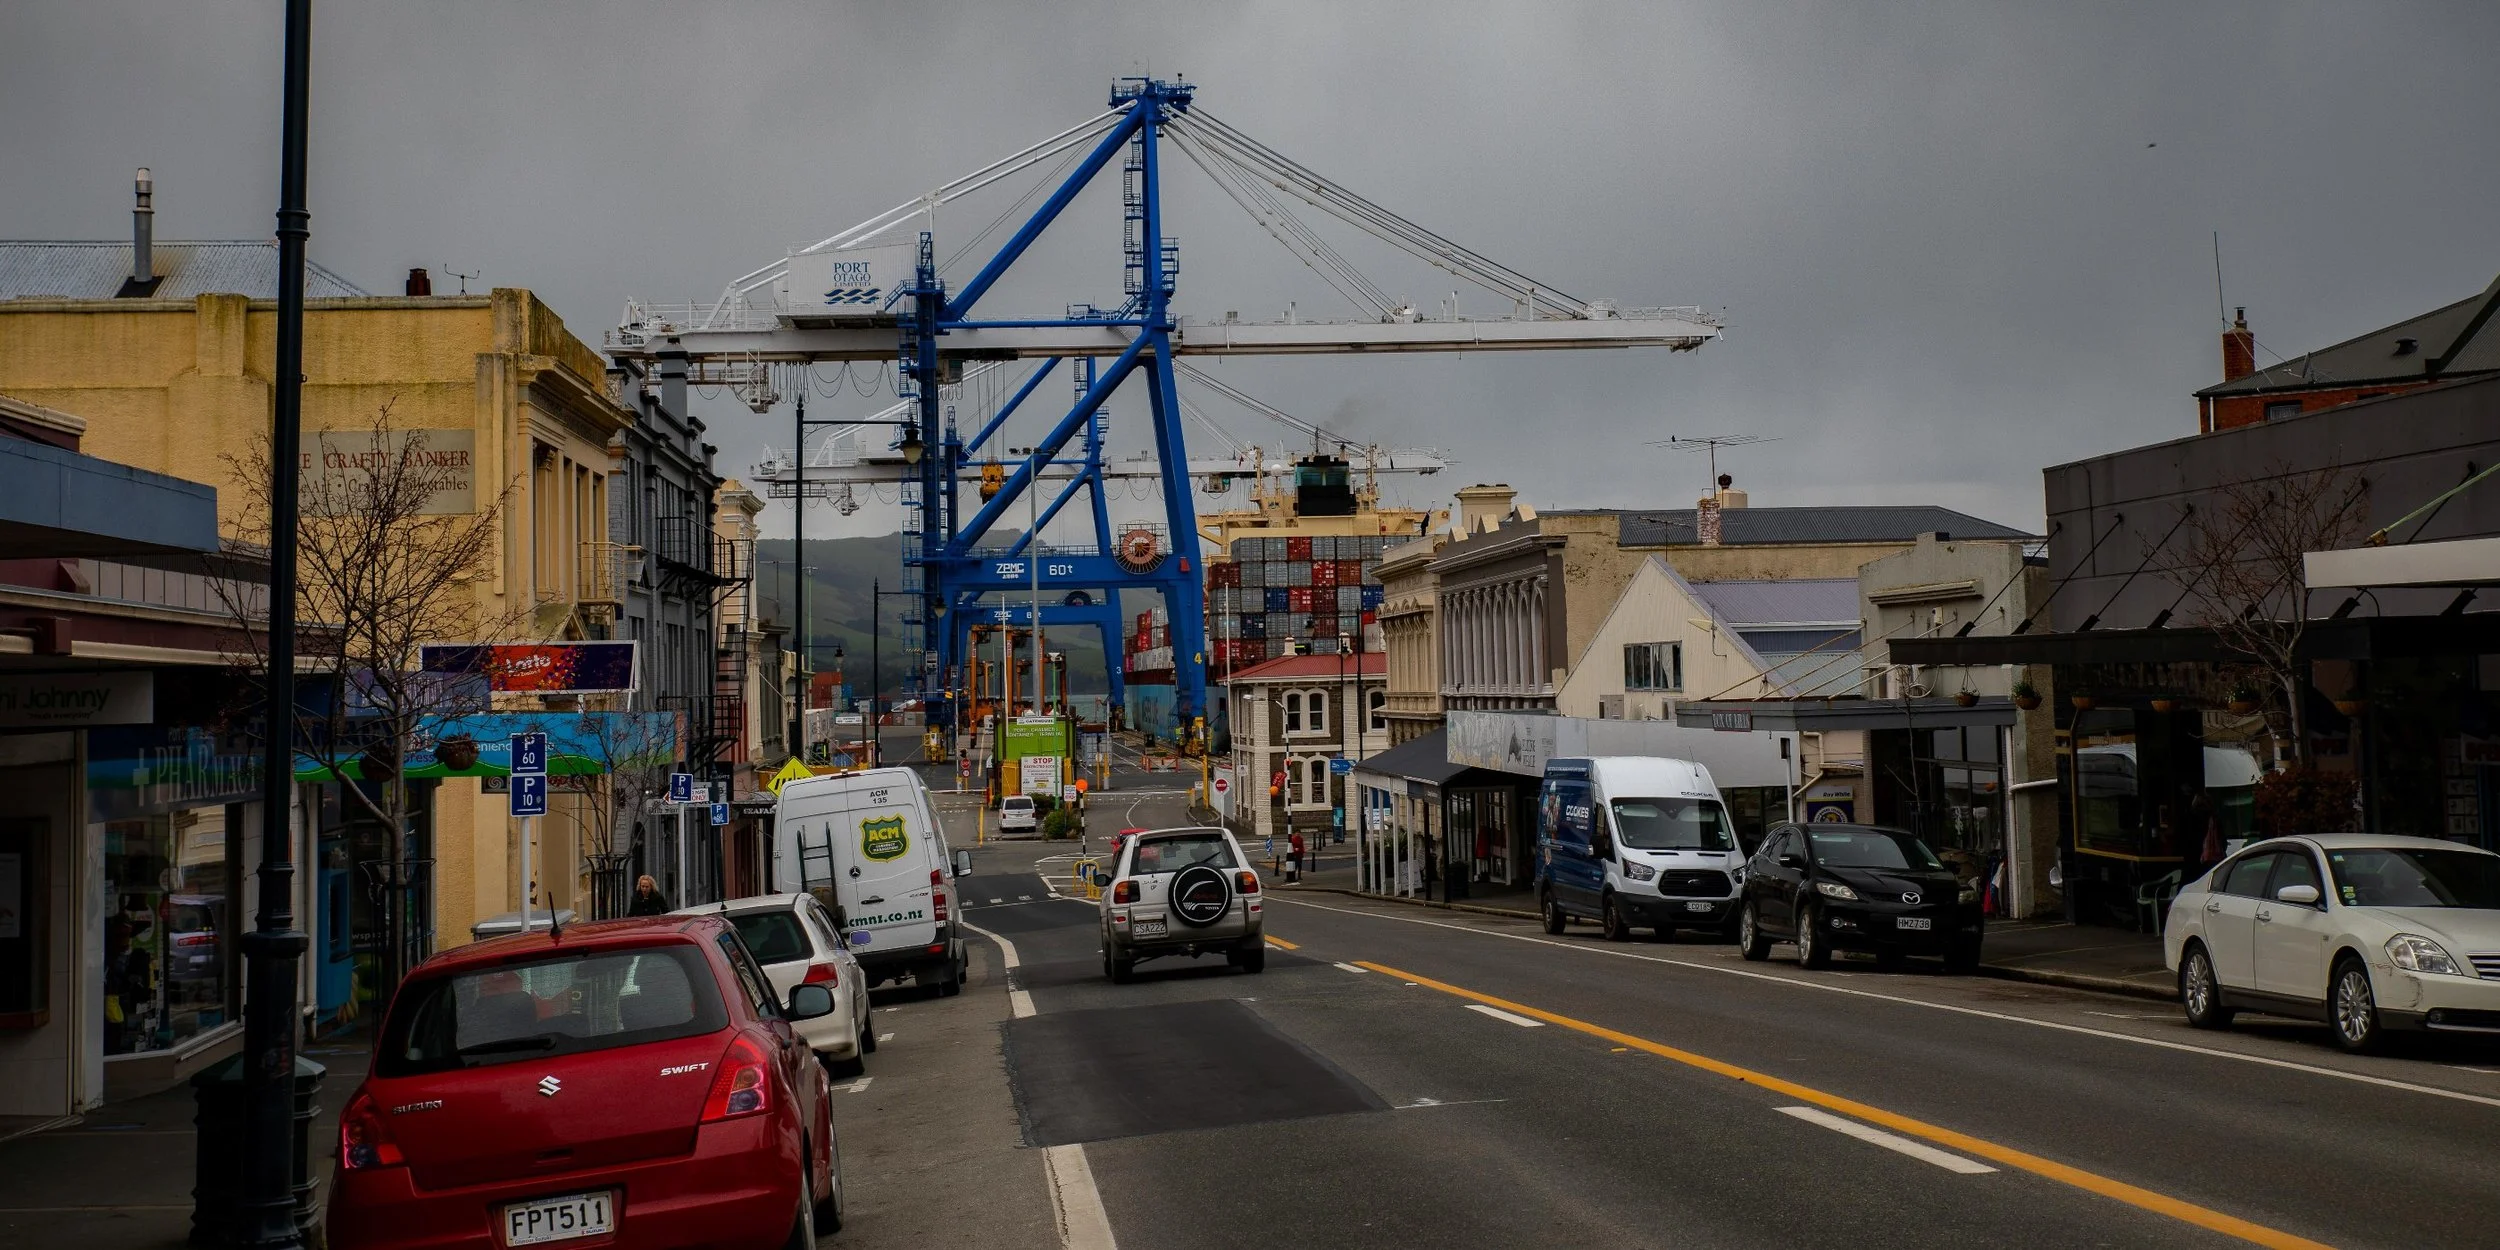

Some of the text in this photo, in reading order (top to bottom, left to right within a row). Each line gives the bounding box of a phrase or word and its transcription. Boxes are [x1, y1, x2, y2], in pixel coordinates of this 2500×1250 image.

[834, 262, 870, 273] PORT
[834, 273, 871, 282] OTAGO
[325, 452, 389, 469] CRAFTY
[405, 450, 471, 468] BANKER
[996, 563, 1073, 576] ZPMC 60t
[1194, 653, 1202, 664] 4
[1116, 666, 1122, 675] 3
[23, 685, 111, 712] Johnny
[524, 736, 535, 751] P
[522, 752, 535, 764] 60
[154, 744, 257, 804] PHARMACY
[678, 775, 686, 786] P
[524, 777, 535, 793] P
[870, 789, 888, 797] ACM
[522, 794, 533, 806] 10
[716, 804, 722, 813] P
[1566, 804, 1589, 819] COOKES
[869, 827, 900, 842] ACM
[848, 909, 923, 928] cmnz.co.nz
[1898, 918, 1930, 929] HMZ738
[1134, 922, 1166, 934] CSA222
[660, 1062, 709, 1076] SWIFT
[392, 1100, 443, 1115] SUZUKI
[511, 1200, 604, 1237] FPT511
